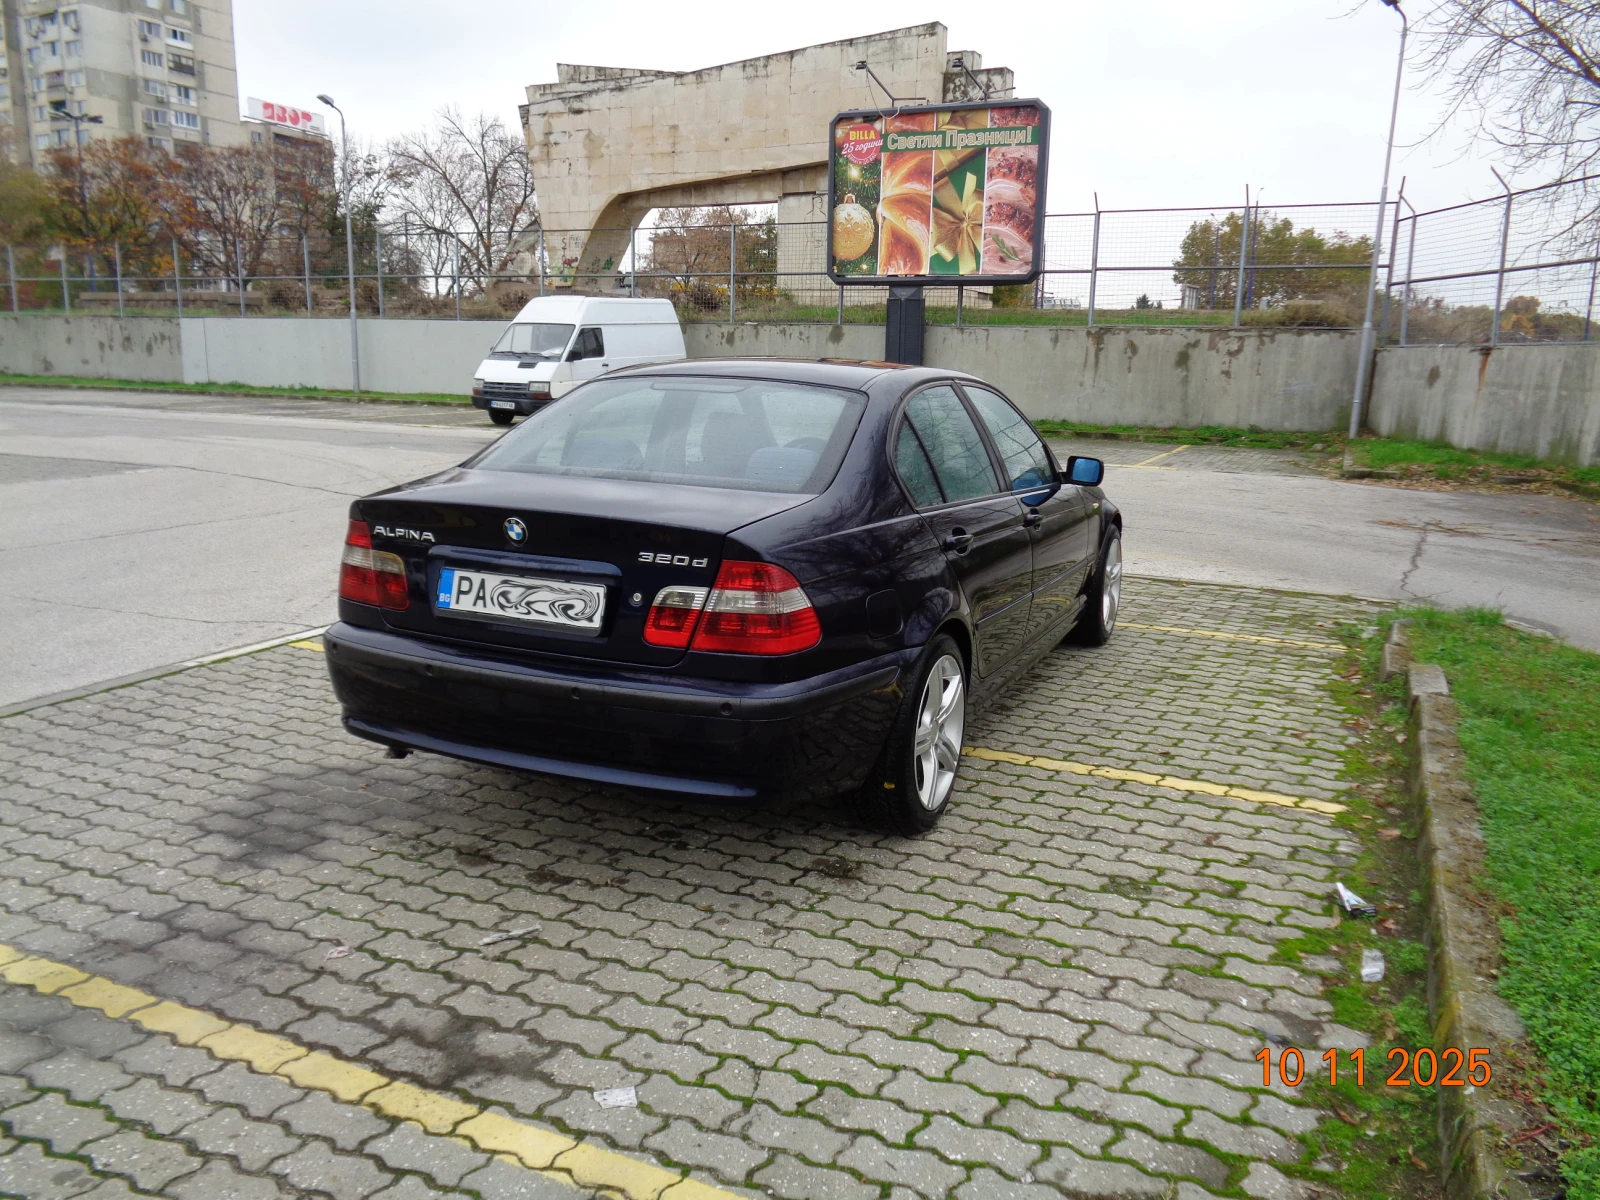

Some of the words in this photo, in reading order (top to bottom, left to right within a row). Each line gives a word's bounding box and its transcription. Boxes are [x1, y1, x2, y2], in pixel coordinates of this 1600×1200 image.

[849, 130, 875, 140] BILLA
[887, 133, 943, 150] Светли
[945, 126, 1032, 150] Празници!
[841, 141, 856, 155] 25
[855, 138, 884, 153] години
[373, 525, 436, 543] ALPINA
[637, 551, 708, 568] 320d
[439, 593, 450, 602] BG
